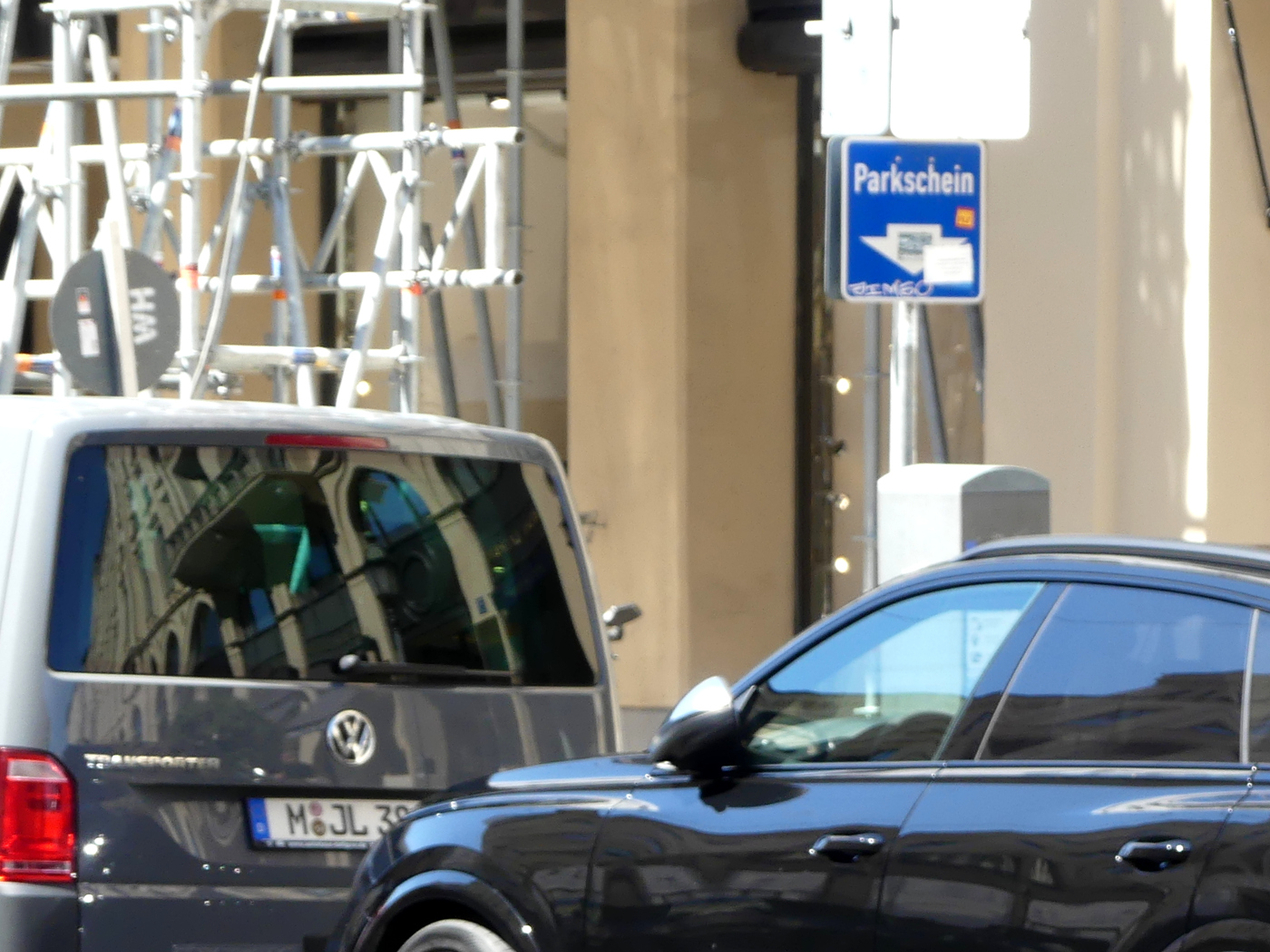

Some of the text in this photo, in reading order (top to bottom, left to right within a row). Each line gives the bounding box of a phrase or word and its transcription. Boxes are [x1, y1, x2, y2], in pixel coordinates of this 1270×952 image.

[853, 161, 975, 195] Parkschein
[286, 803, 308, 835] M
[330, 803, 368, 836] JL
